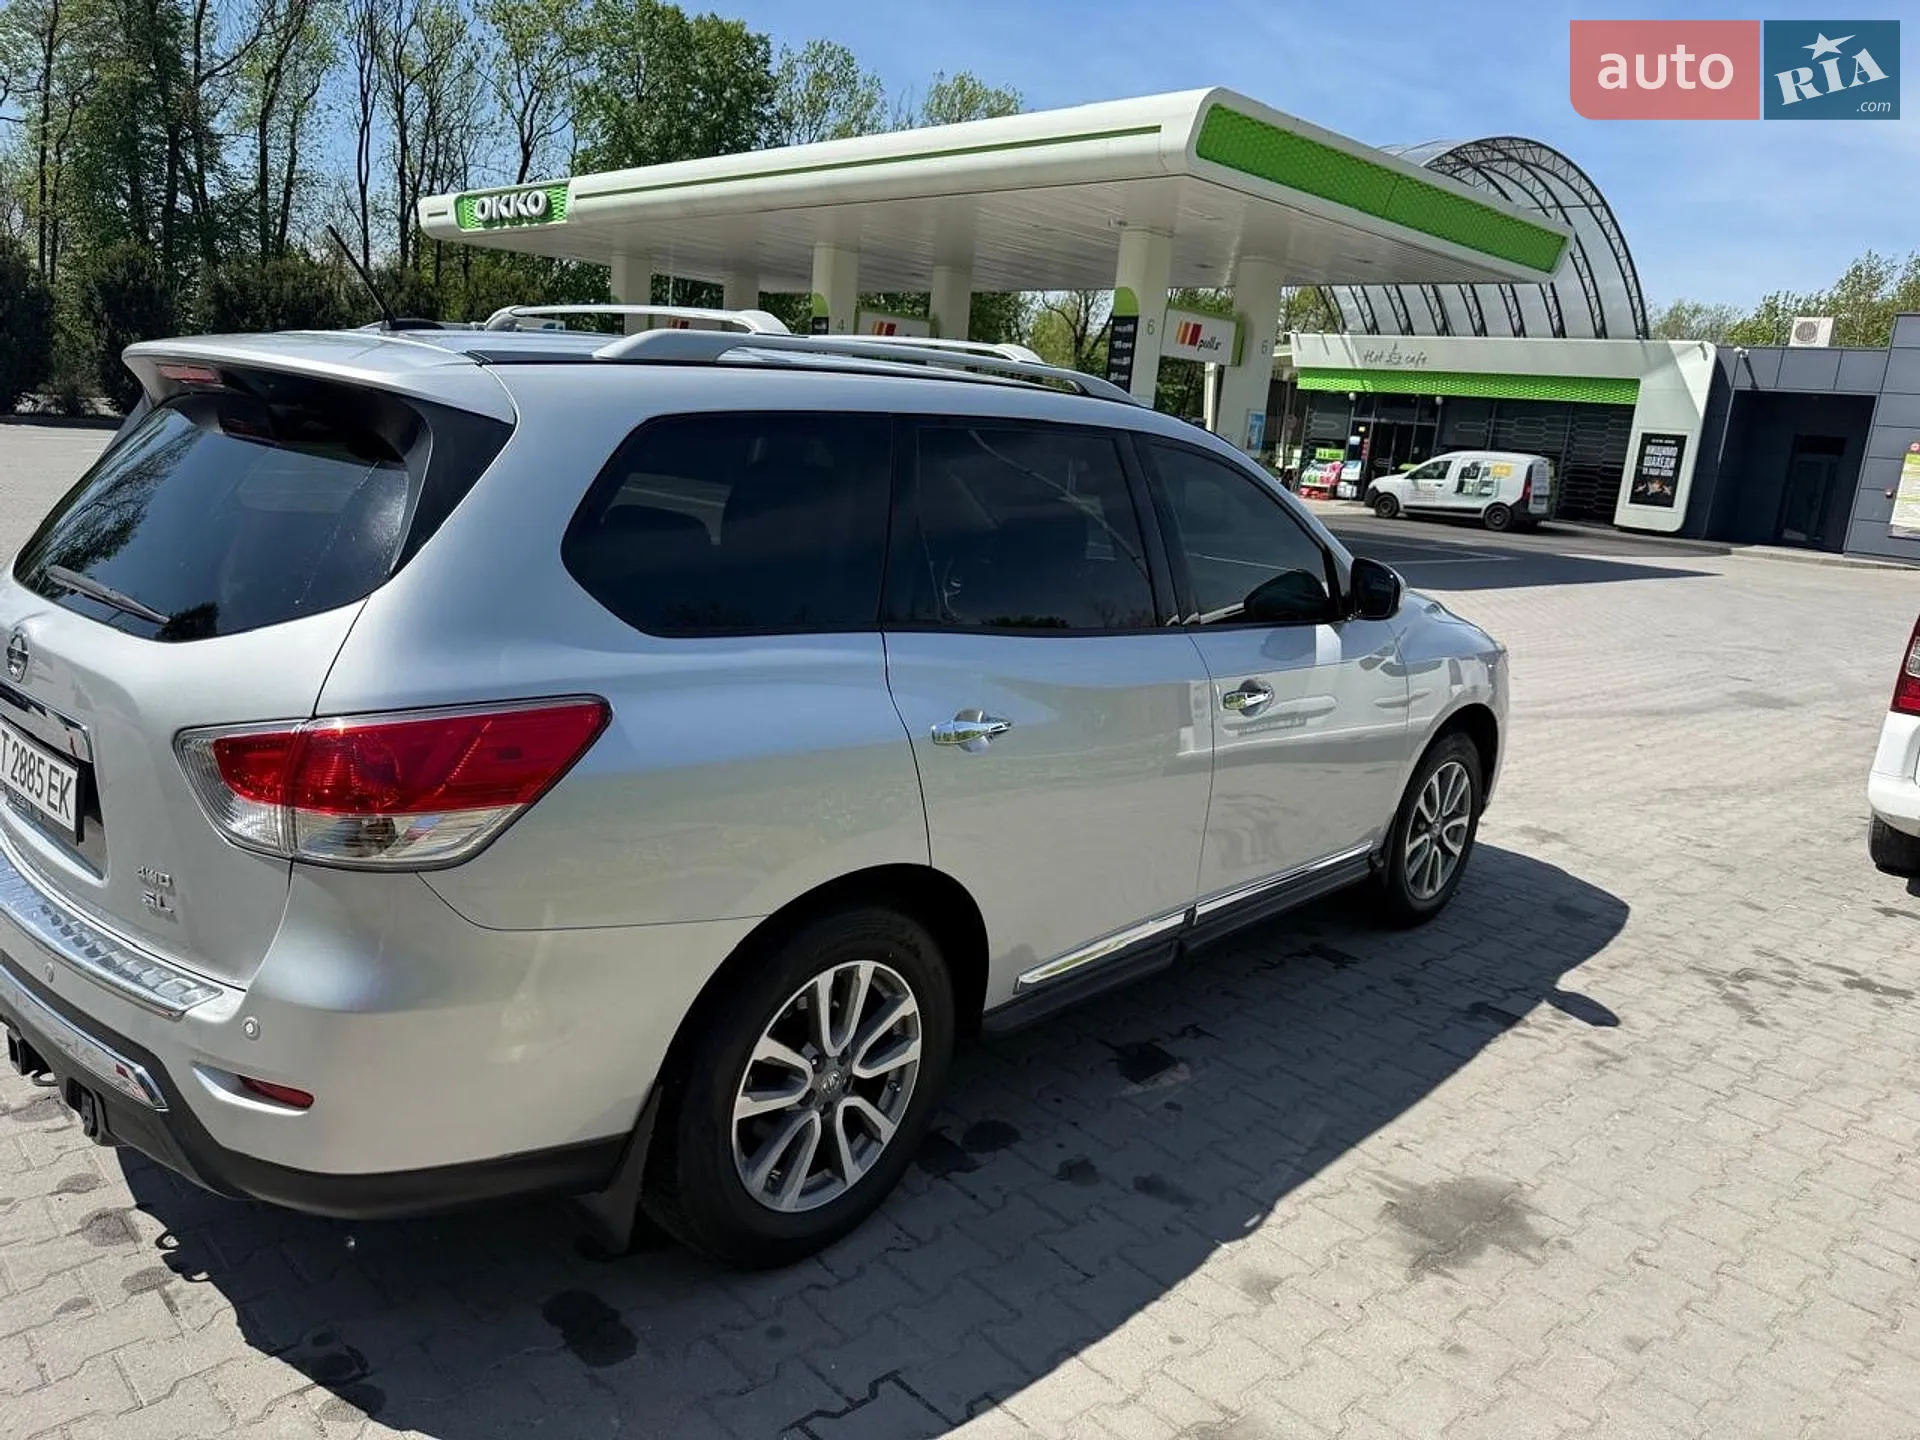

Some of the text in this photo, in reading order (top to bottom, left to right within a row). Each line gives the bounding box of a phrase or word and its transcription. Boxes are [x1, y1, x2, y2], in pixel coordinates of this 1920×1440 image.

[474, 189, 547, 221] OKKO
[1147, 318, 1155, 335] 6
[1261, 340, 1268, 355] 6
[10, 740, 45, 799] 2885
[47, 763, 73, 820] EK
